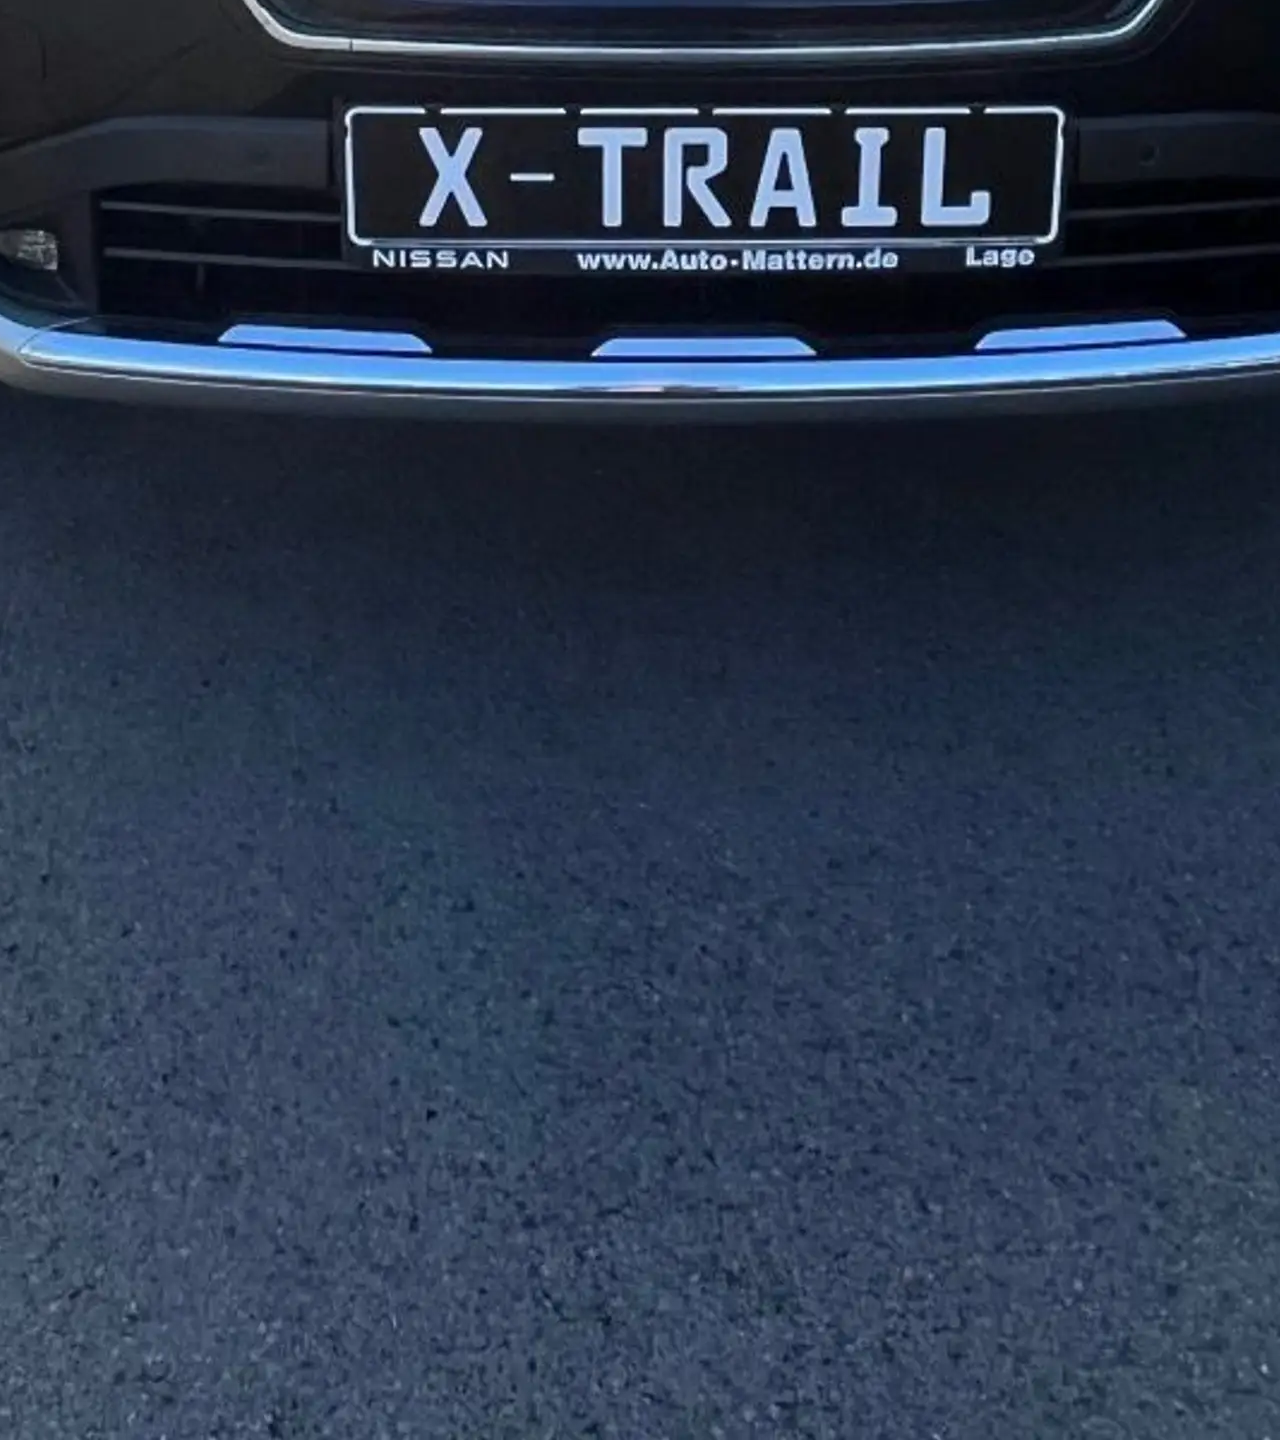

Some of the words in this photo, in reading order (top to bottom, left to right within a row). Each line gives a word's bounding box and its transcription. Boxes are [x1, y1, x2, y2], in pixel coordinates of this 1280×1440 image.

[419, 127, 990, 227] X-TRAIL
[373, 250, 509, 268] NISSAN
[577, 247, 898, 271] www.Auto-Mattern.de
